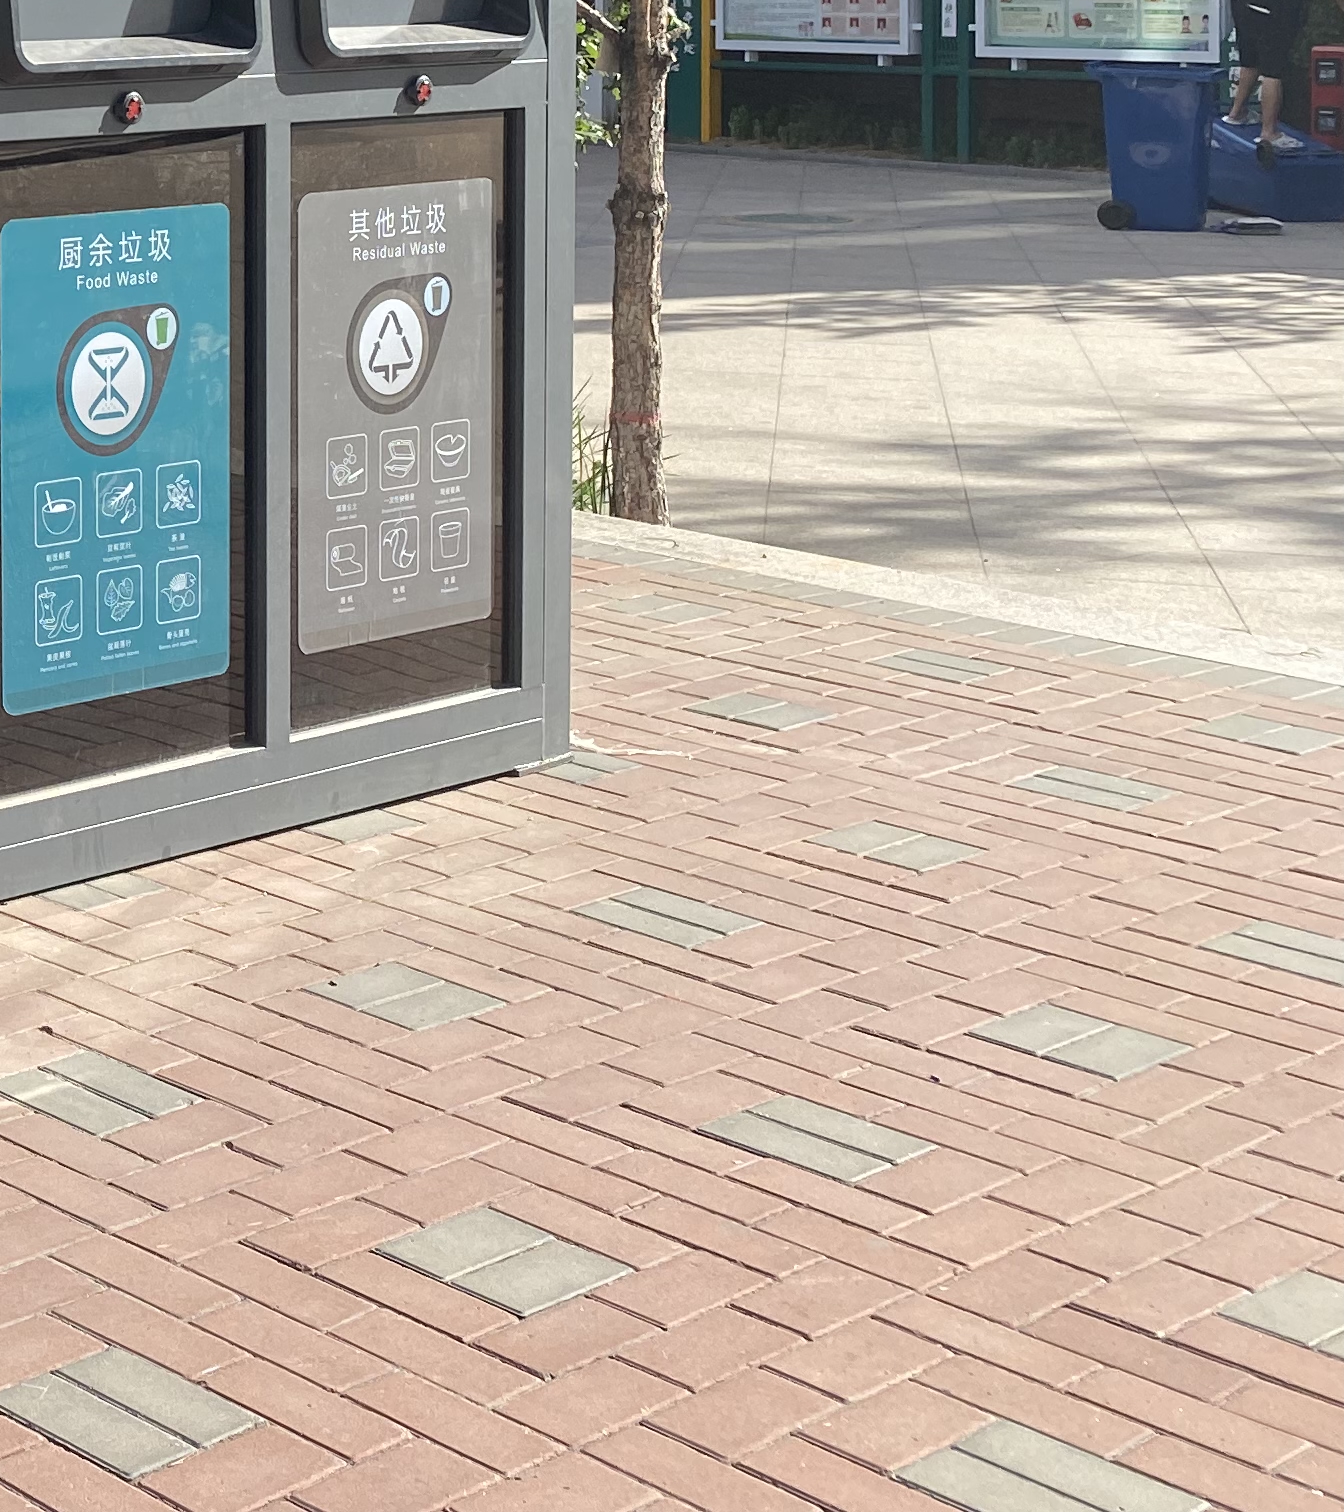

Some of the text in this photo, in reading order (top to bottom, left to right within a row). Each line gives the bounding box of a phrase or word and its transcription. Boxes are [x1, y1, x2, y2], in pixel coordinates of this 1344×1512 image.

[348, 202, 447, 242] 其他垃圾
[58, 228, 172, 271] 厨余垃圾
[352, 240, 446, 262] Residual Waste
[76, 269, 159, 291] Food Waste
